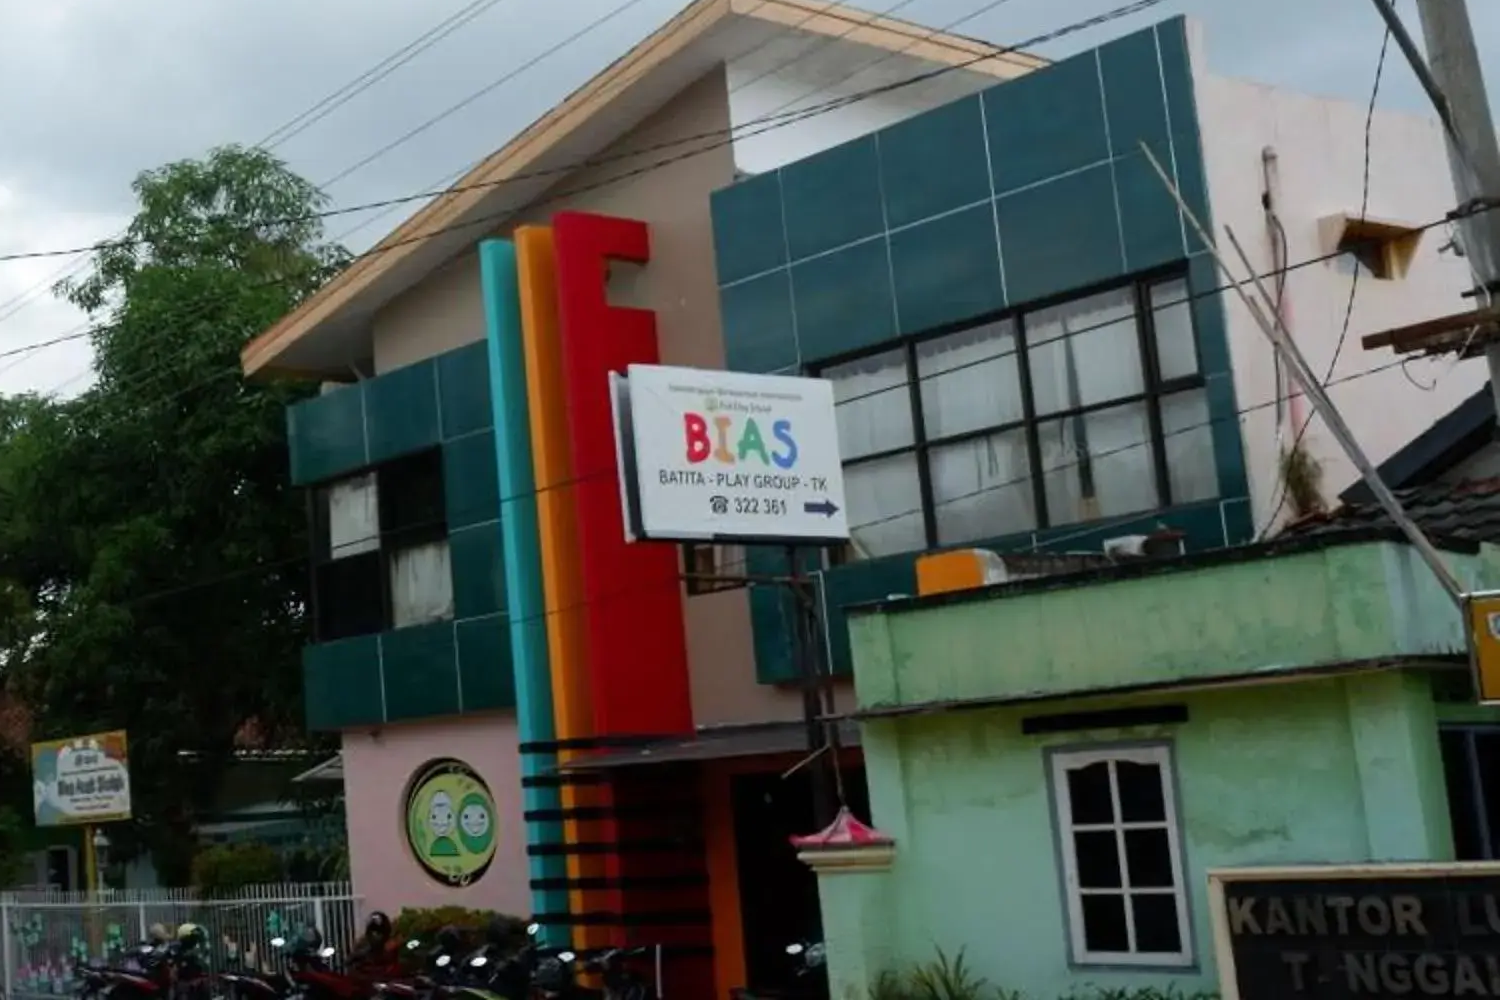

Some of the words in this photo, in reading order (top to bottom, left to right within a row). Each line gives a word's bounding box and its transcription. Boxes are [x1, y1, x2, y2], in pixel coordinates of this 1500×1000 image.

[684, 412, 798, 469] BIAS
[659, 469, 705, 486] BATITA
[717, 472, 749, 487] PLAY
[754, 474, 800, 490] GROUP
[812, 477, 828, 491] TK
[733, 498, 759, 514] 322
[1228, 895, 1428, 935] KANTOR
